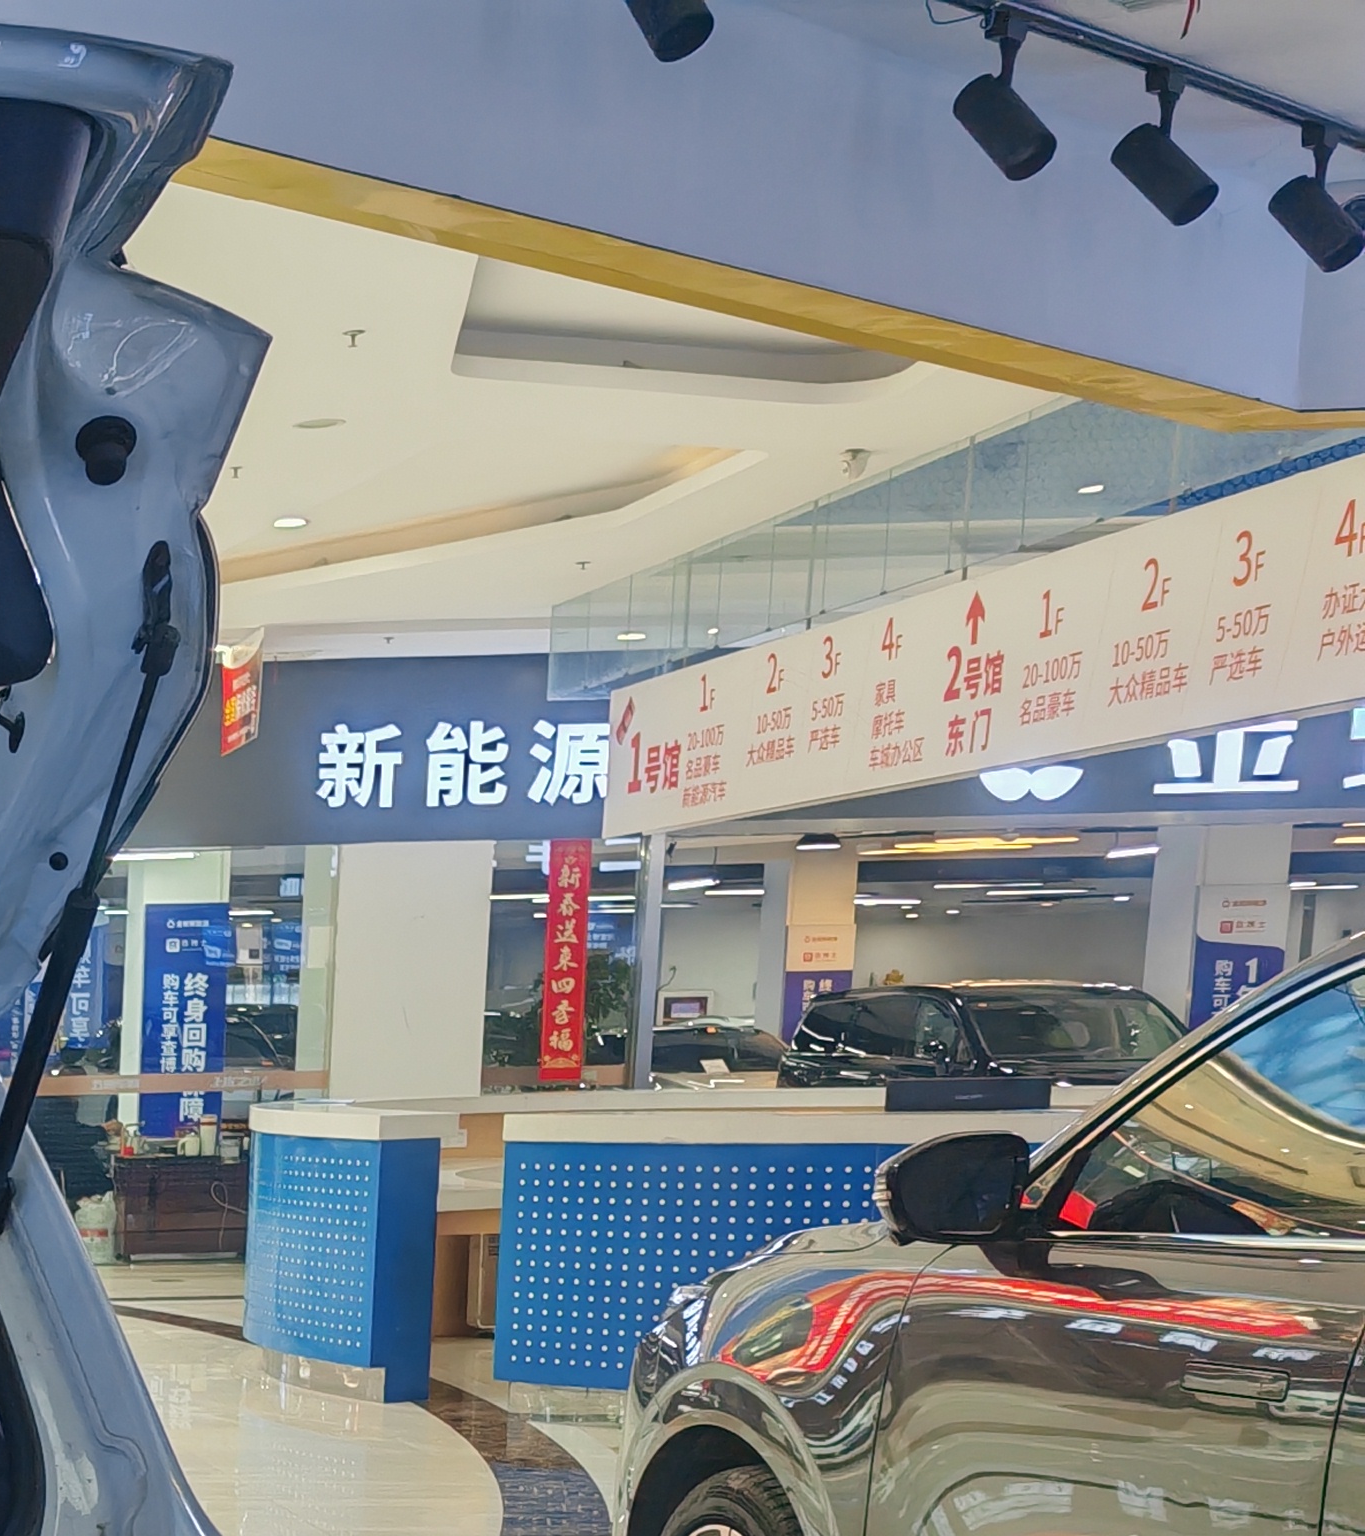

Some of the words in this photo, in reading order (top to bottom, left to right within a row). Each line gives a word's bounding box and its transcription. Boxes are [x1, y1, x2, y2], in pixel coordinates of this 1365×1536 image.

[1232, 530, 1266, 587] 3F
[1141, 558, 1172, 612] 2F
[1039, 589, 1065, 639] 1F
[1215, 603, 1272, 643] 5-50万
[821, 635, 842, 679] 3F
[881, 617, 903, 661] 4F
[1111, 629, 1171, 668] 10-50万
[766, 653, 785, 694] 2F
[943, 645, 1004, 702] 2号馆
[1022, 651, 1083, 689] 20-100万
[1107, 662, 1189, 708] 大众精品车
[1209, 645, 1265, 686] 严选车
[699, 673, 716, 712] 1F
[810, 693, 845, 721] 5-50万
[874, 678, 896, 706] 家具
[1019, 688, 1076, 726] 名品豪车
[756, 706, 792, 735] 10-50万
[807, 724, 841, 753] 严选车
[945, 707, 992, 757] 东门
[315, 719, 610, 810] 新能源
[627, 731, 682, 794] 1号馆
[745, 735, 795, 768] 大众精品车
[1153, 707, 1365, 795] 亚
[1212, 959, 1234, 1015] 购车可
[179, 971, 209, 1123] 终身回购障
